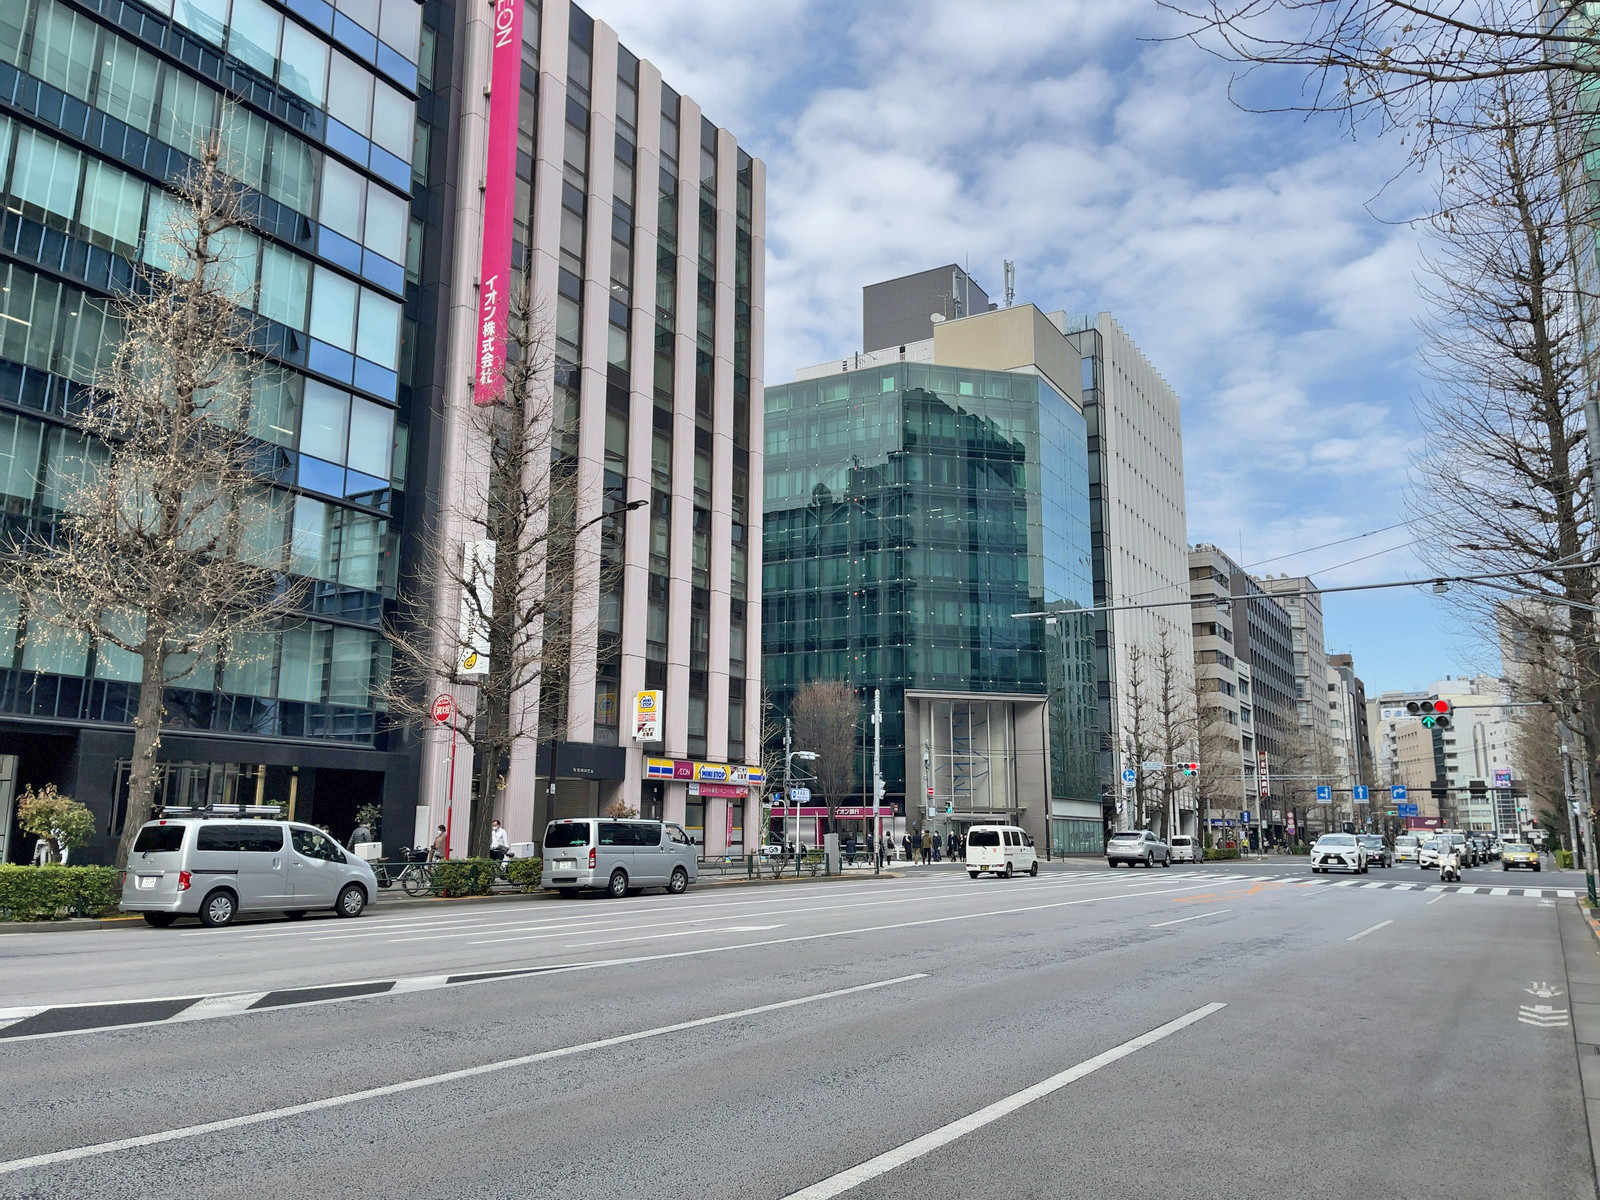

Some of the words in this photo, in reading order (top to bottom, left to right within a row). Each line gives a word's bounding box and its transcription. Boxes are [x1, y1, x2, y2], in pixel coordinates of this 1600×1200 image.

[480, 275, 498, 385] イオン株式会社
[713, 771, 726, 779] STOP
